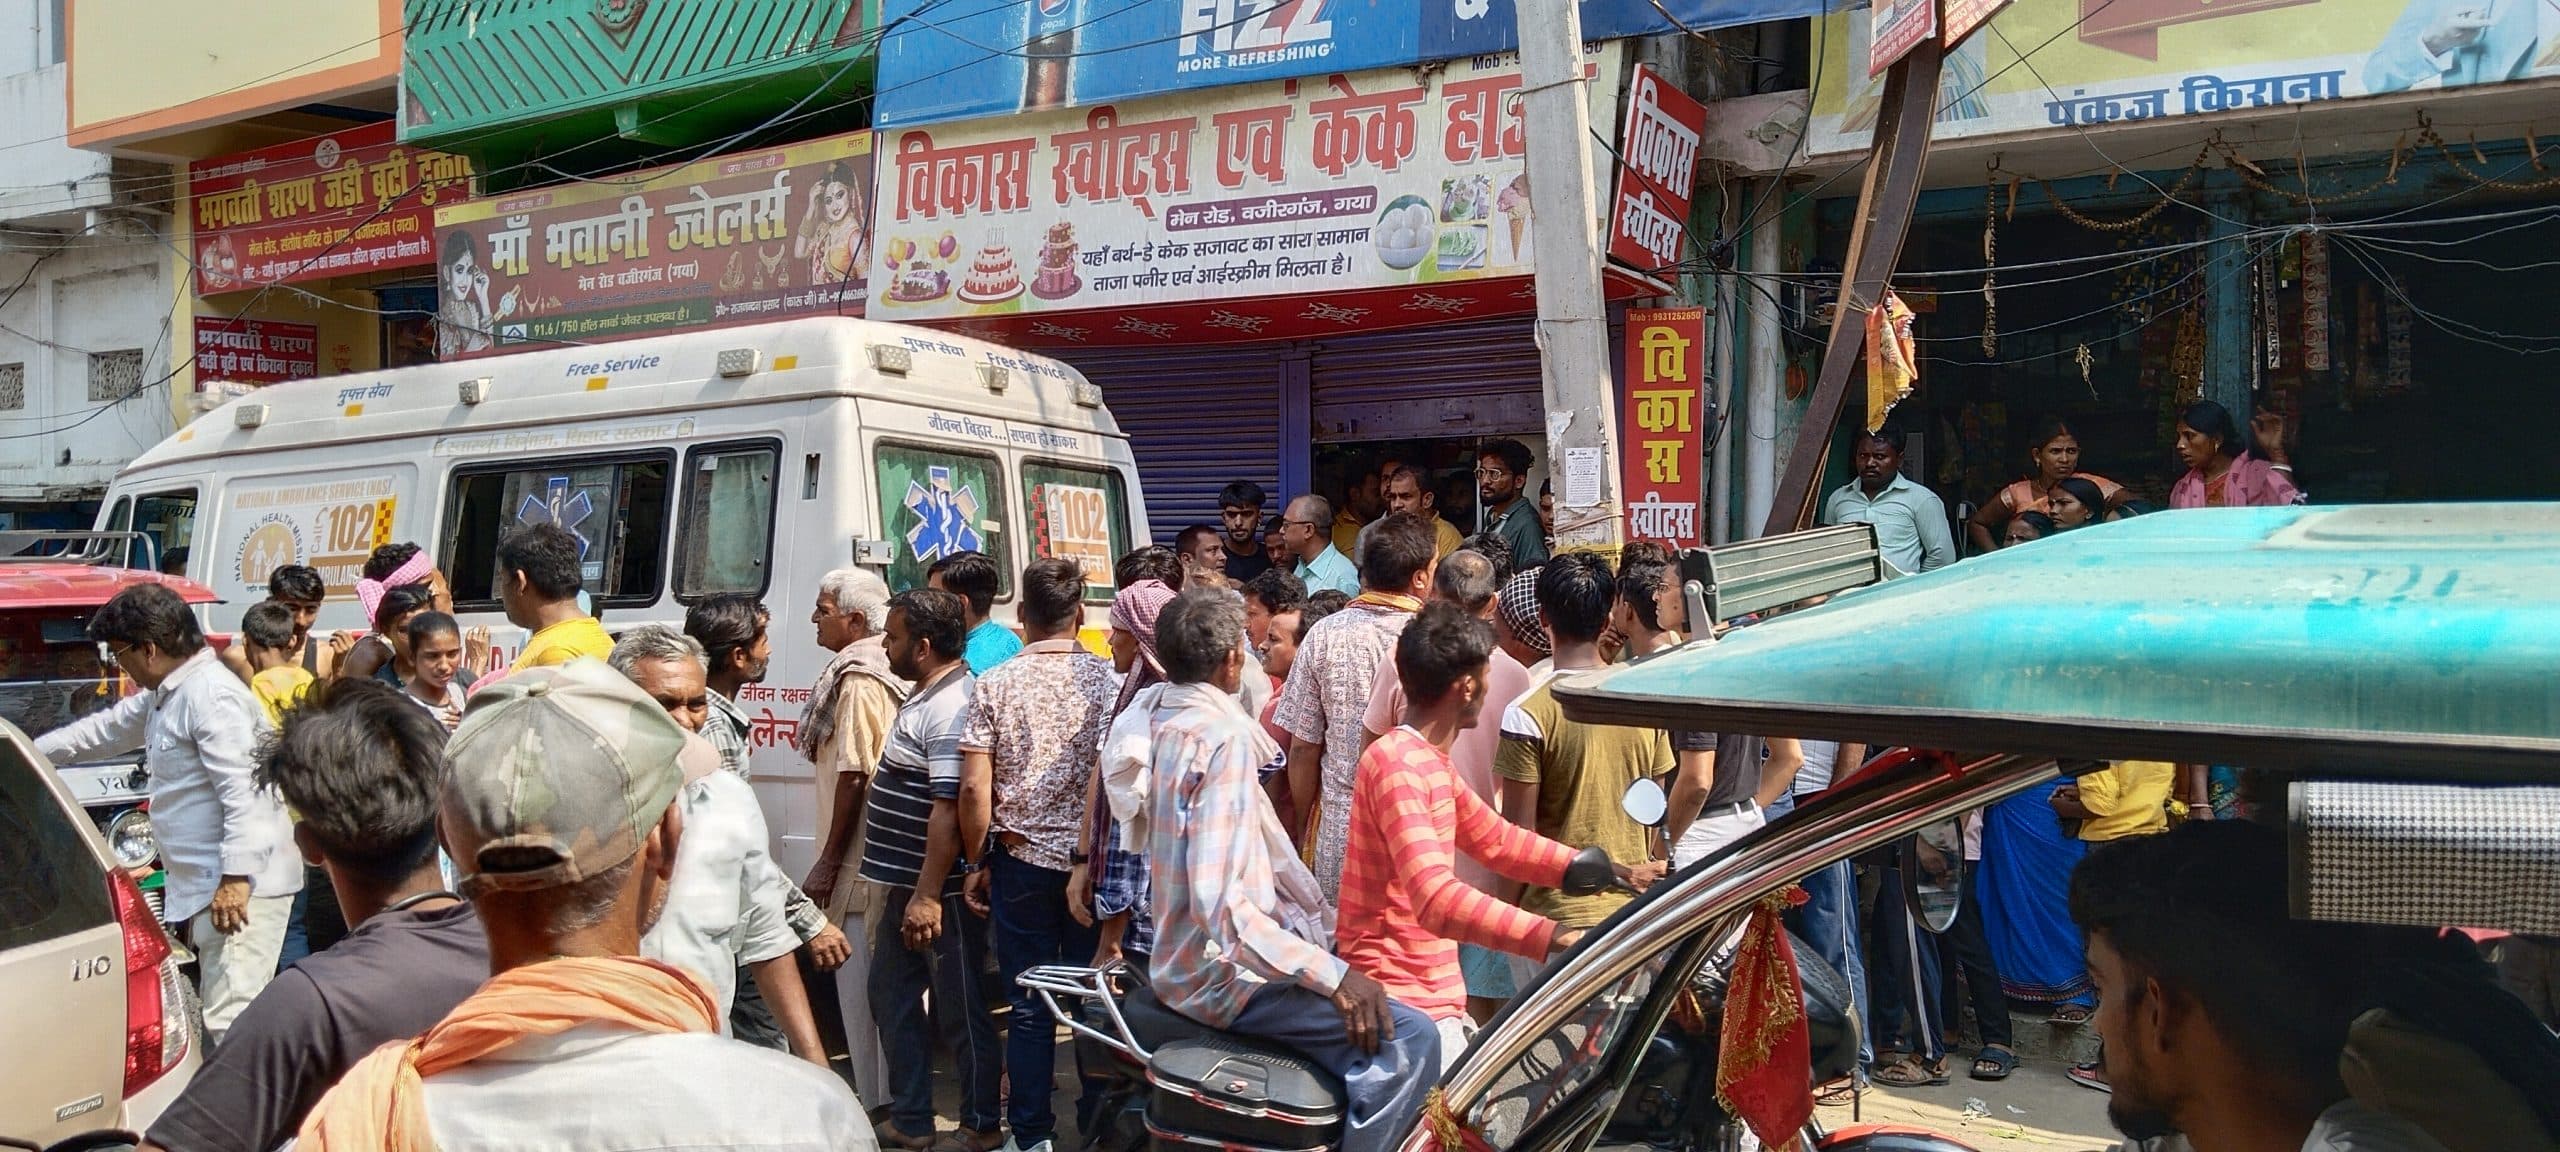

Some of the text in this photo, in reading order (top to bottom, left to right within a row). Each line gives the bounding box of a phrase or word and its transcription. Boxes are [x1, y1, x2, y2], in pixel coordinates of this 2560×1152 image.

[1040, 18, 1066, 32] pepsi
[1178, 0, 1333, 56] FIZZ
[1176, 56, 1222, 74] MORE
[1471, 54, 1500, 71] Mob
[2044, 69, 2346, 127] पंकज किराना
[896, 130, 1037, 221] विकास
[1051, 105, 1198, 219] स्वीट्स
[1212, 79, 1295, 188] एवं
[1310, 74, 1425, 176] केक
[1630, 77, 1700, 200] विकास
[199, 179, 262, 230] भगवती
[267, 178, 316, 219] शरण
[321, 158, 364, 216] जड़ी
[369, 149, 409, 212] बूटी
[546, 195, 654, 269] भवानी
[665, 170, 791, 251] ज्वेलर्स
[1170, 194, 1372, 228] मेन रोड, वजीरगंज, गया
[248, 239, 263, 256] मेन
[324, 226, 333, 244] के
[392, 216, 419, 235] (गया)
[1622, 191, 1682, 268] स्वीट्स
[329, 254, 351, 267] सामान
[351, 247, 368, 265] उचित
[387, 246, 397, 259] पर
[397, 240, 420, 258] मिलता
[1082, 227, 1370, 267] यहाँ बर्थ-डे केक सजावट का सारा सामान
[578, 260, 700, 291] मेन रोड वजीरगंज (गया)
[1093, 275, 1128, 292] ताजा
[1132, 267, 1168, 289] पनीर
[1171, 265, 1193, 286] एवं
[1196, 259, 1270, 287] आईस्क्रीम
[1275, 256, 1326, 279] मिलता
[199, 327, 314, 354] भगवती शरण
[580, 319, 598, 333] हॉल
[600, 314, 619, 329] मार्क
[199, 352, 217, 373] जड़ी
[566, 355, 660, 377] Free Service
[937, 341, 966, 357] सेवा
[986, 352, 1066, 380] Free Service
[368, 380, 394, 399] सेवा
[928, 412, 963, 434] जीवन्त
[1010, 428, 1036, 444] सपना
[1050, 431, 1079, 450] साकार
[327, 503, 375, 552] 102
[1061, 490, 1107, 541] 102
[1628, 491, 1696, 551] स्वीट्स
[234, 523, 259, 582] NATIONAL
[262, 512, 294, 528] HEALTH
[311, 526, 323, 553] Call
[741, 680, 776, 702] जीवन
[72, 955, 111, 982] i10
